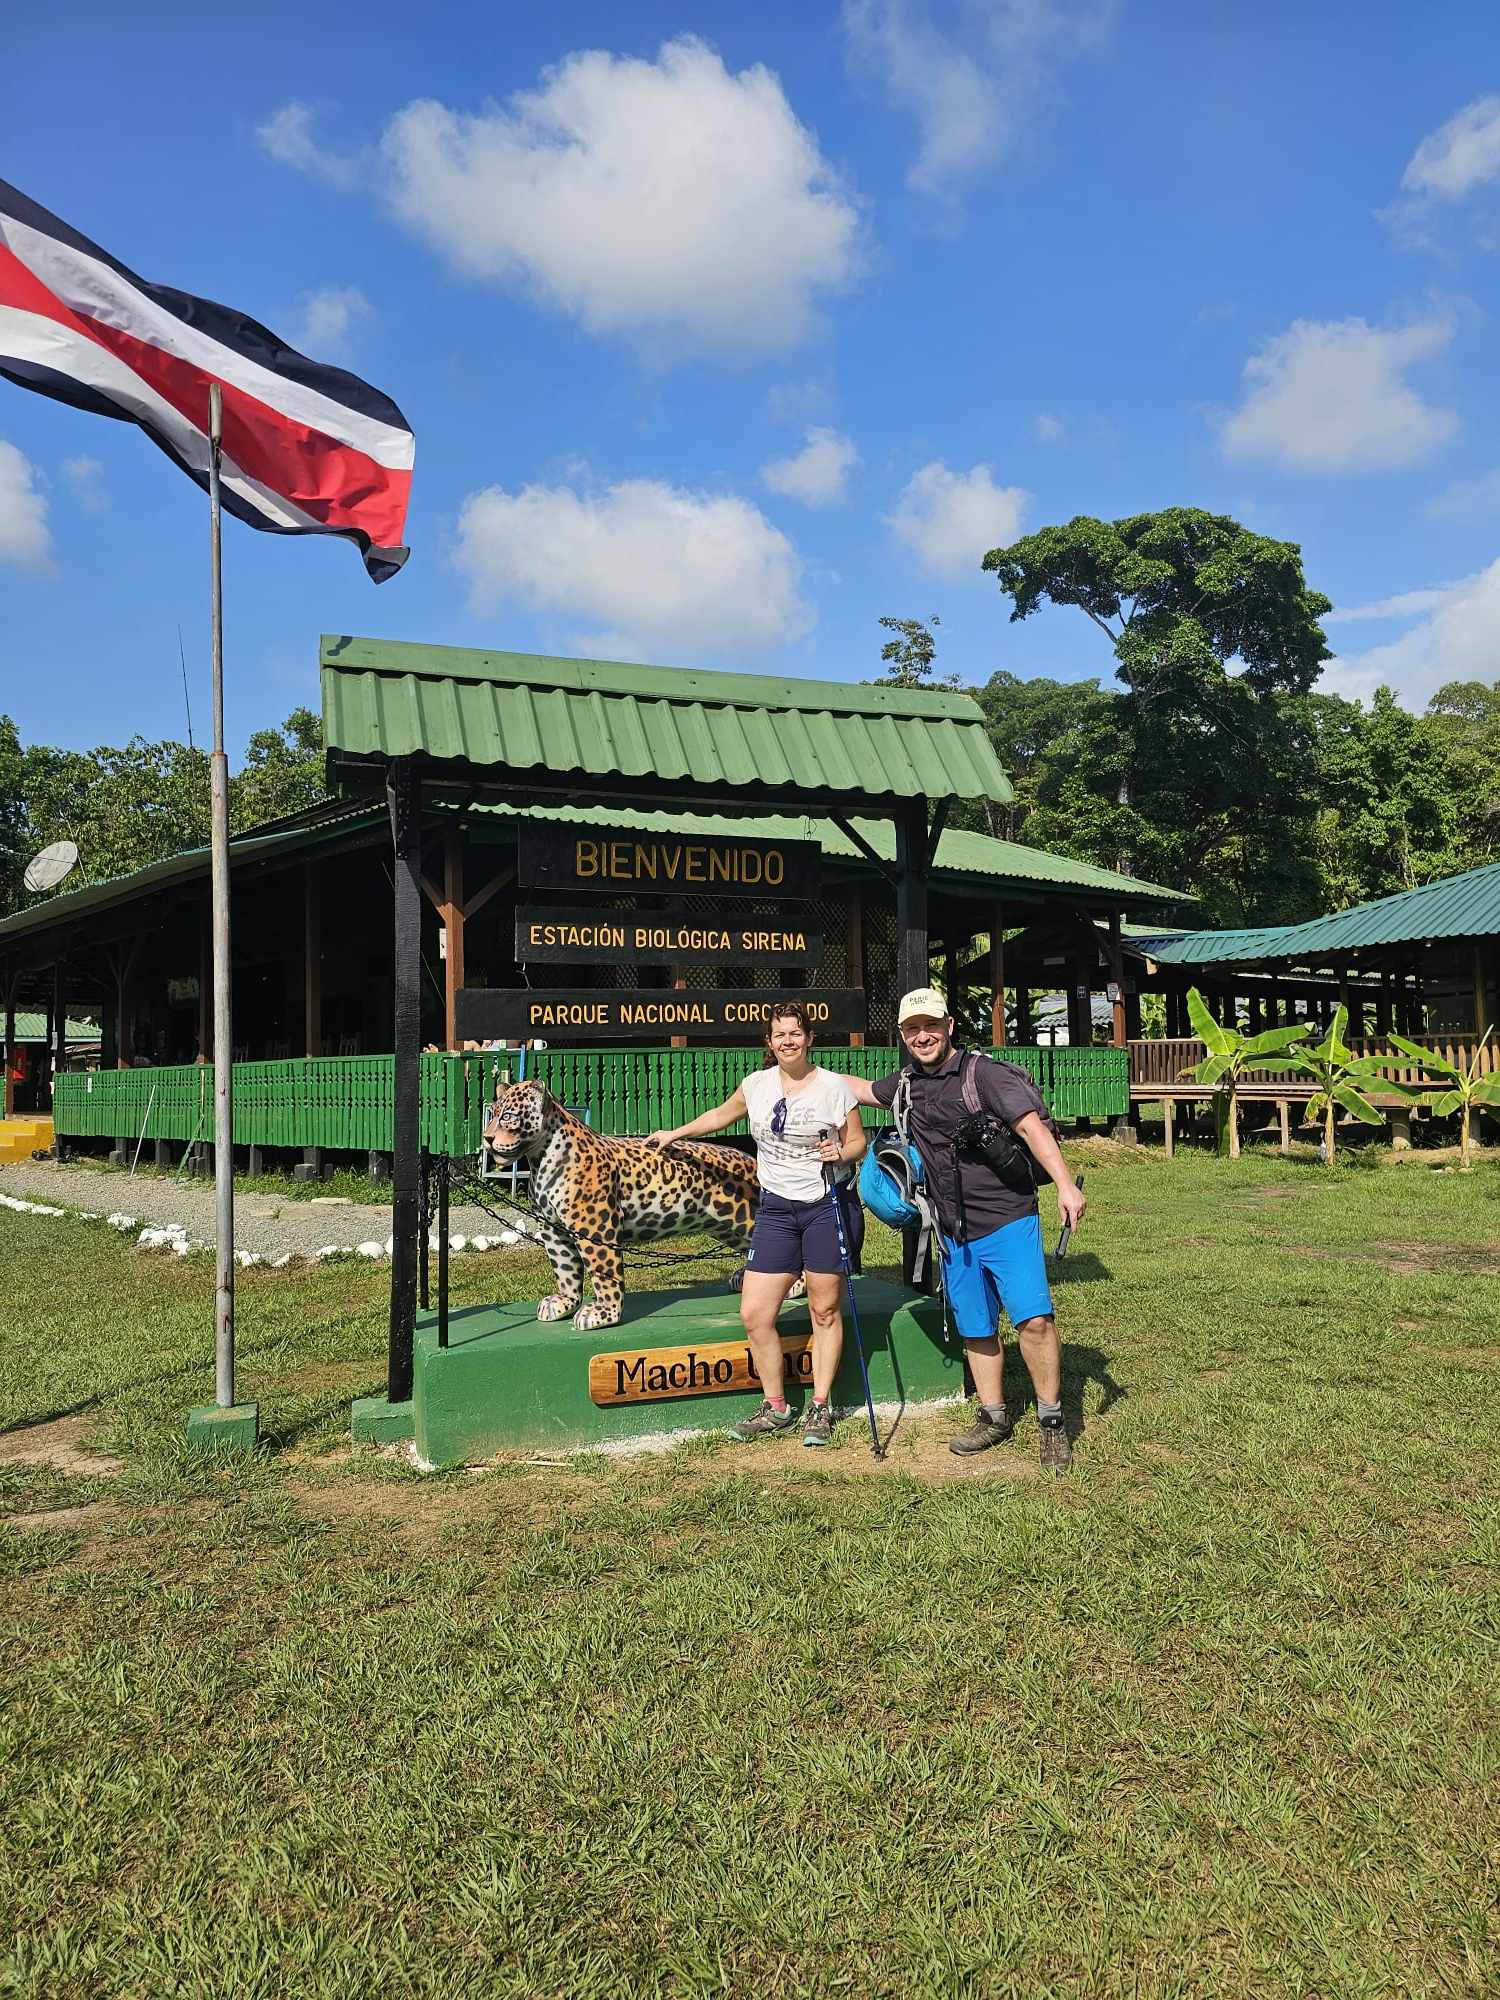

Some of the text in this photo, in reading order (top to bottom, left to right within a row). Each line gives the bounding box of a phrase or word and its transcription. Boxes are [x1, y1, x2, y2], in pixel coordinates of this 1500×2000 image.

[575, 840, 785, 885] BIENVENIDO
[529, 923, 806, 951] ESTACIÓN BIOLÓGICA SIRENA
[529, 1003, 829, 1025] PARQUE NACIONAL CORCDO
[614, 1352, 733, 1395] Macho
